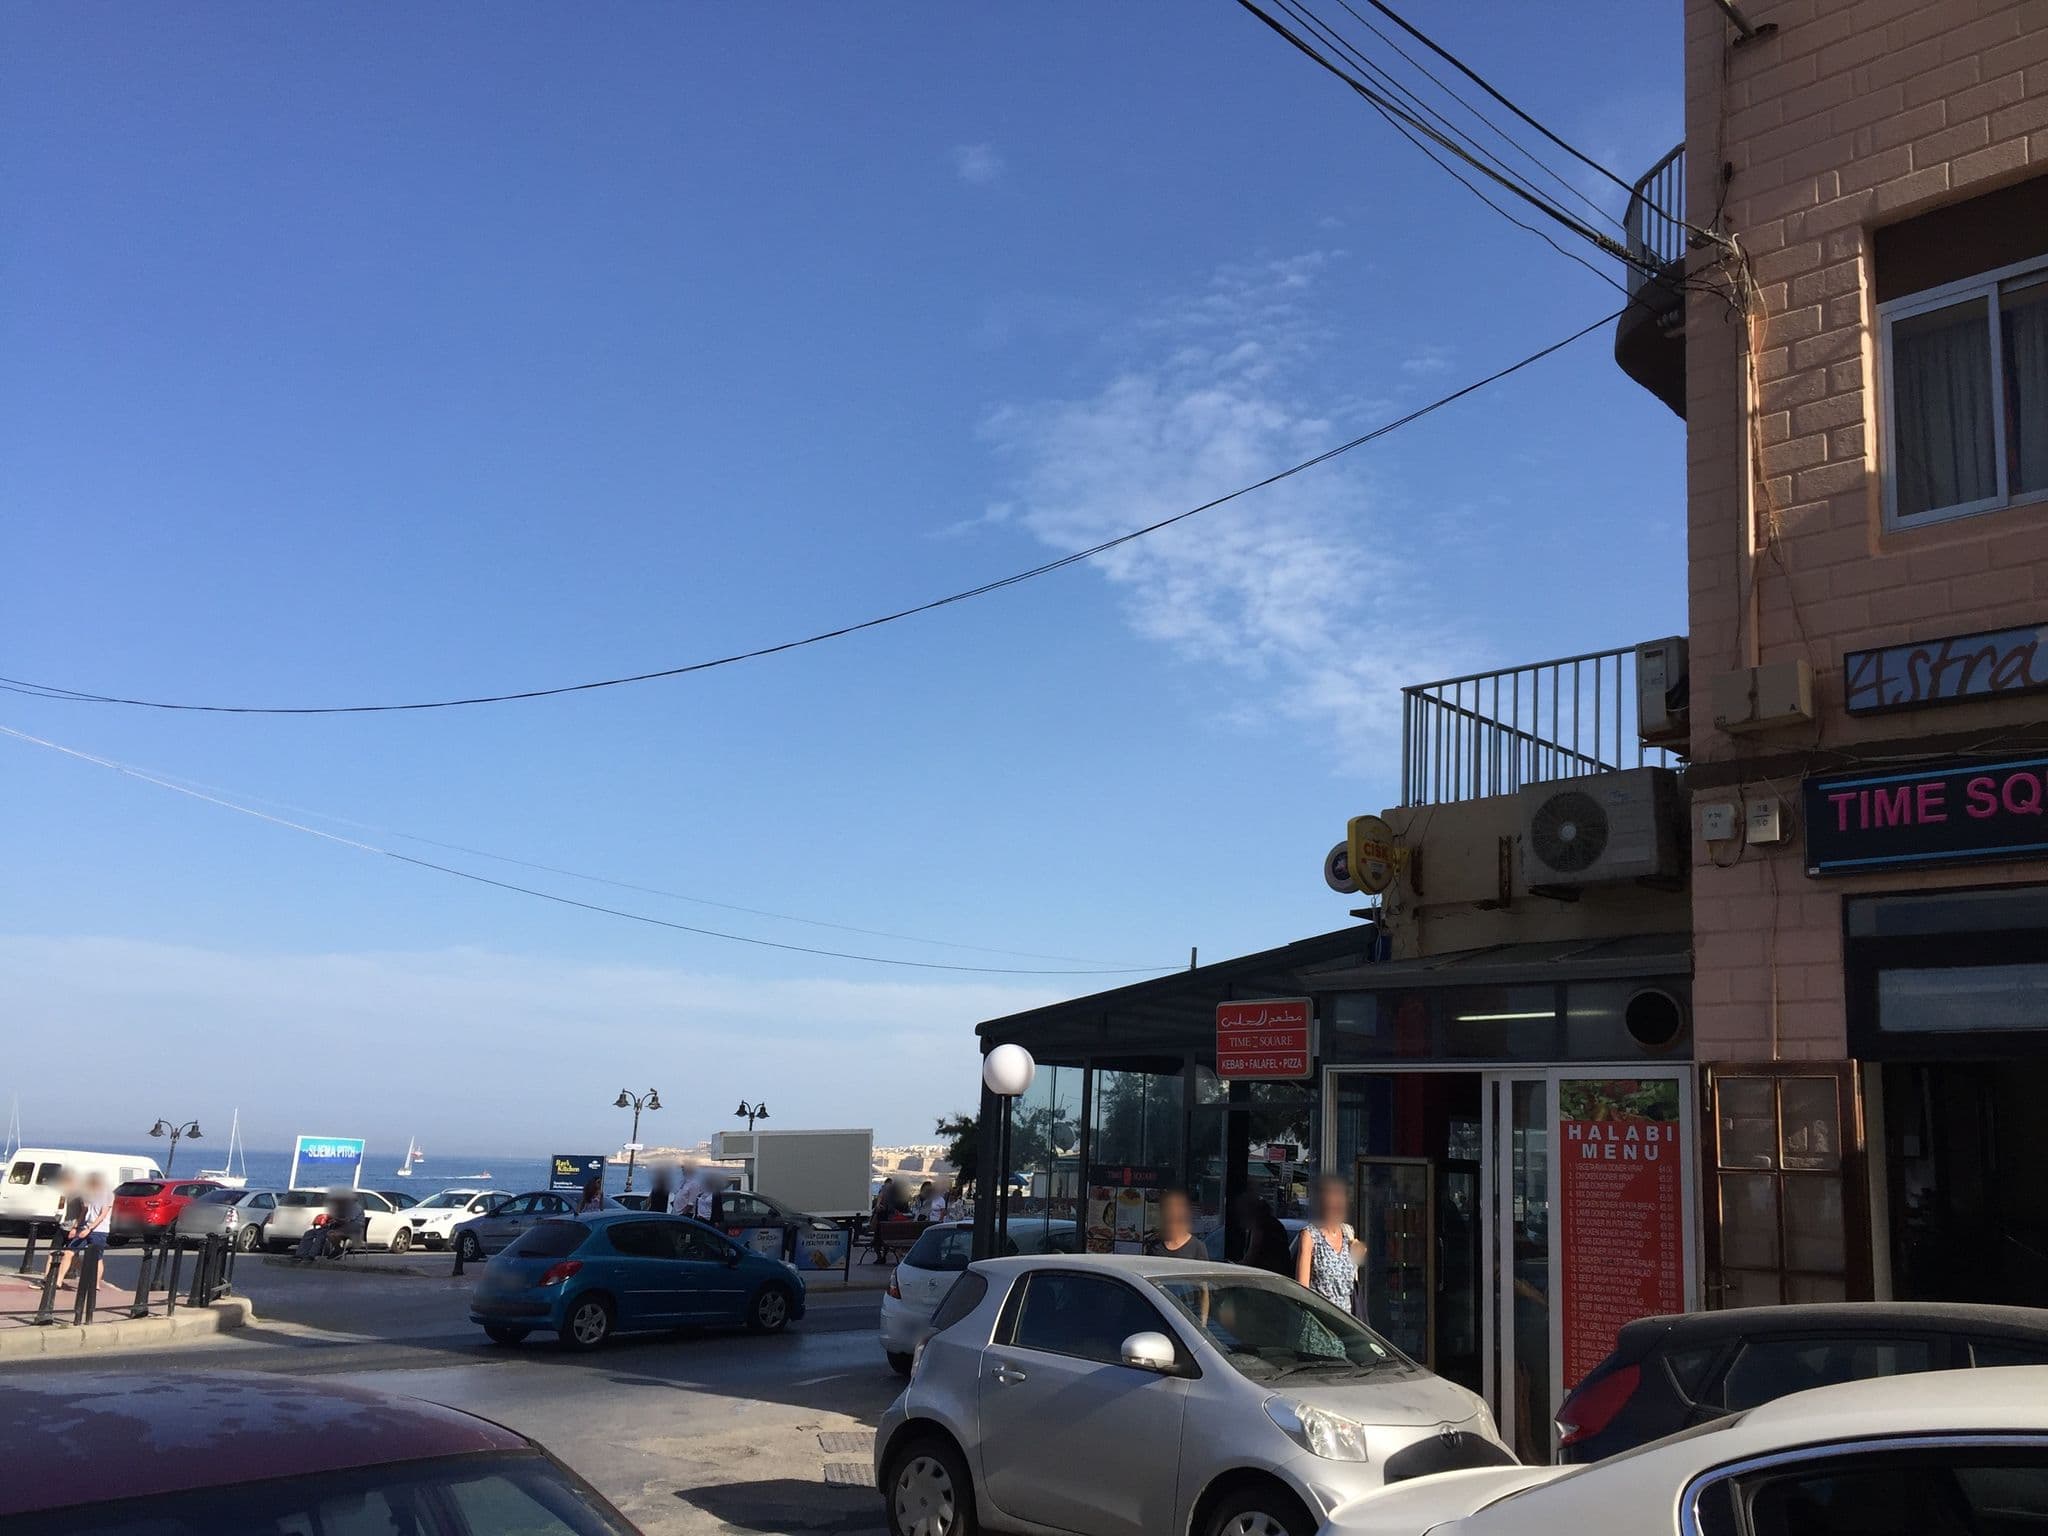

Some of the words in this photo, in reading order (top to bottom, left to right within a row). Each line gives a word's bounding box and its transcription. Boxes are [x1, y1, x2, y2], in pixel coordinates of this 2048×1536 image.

[1828, 782, 1948, 832] TIME
[1966, 771, 2048, 820] SQ
[1268, 1010, 1302, 1026] مطعم
[1229, 1037, 1251, 1048] TIME
[1259, 1035, 1294, 1047] SQUARE
[1221, 1059, 1245, 1070] KEBAB
[1249, 1058, 1278, 1069] FALAFEL
[1283, 1057, 1303, 1068] PIZZA
[1567, 1124, 1674, 1142] HALABI
[1582, 1143, 1660, 1161] MENU
